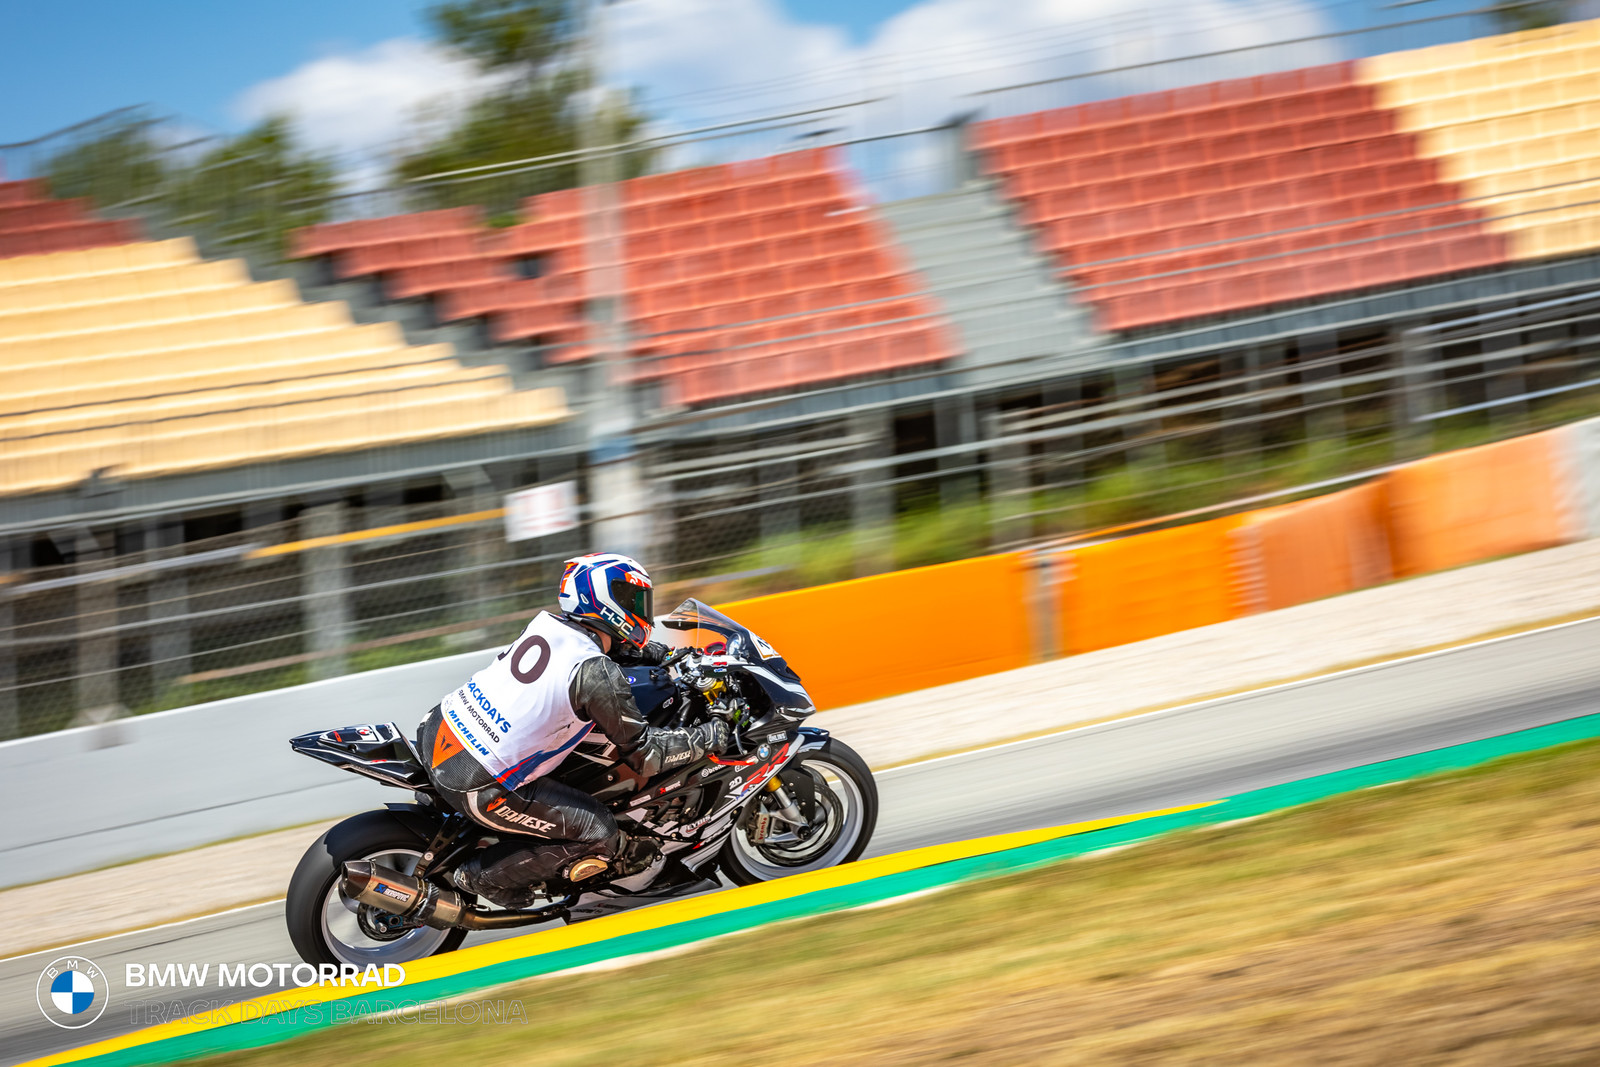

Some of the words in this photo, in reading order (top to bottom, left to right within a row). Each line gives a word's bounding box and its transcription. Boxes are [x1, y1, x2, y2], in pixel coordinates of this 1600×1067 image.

[600, 606, 634, 635] HJC
[448, 709, 490, 757] MICHELIN
[466, 705, 500, 744] MOTORRAD
